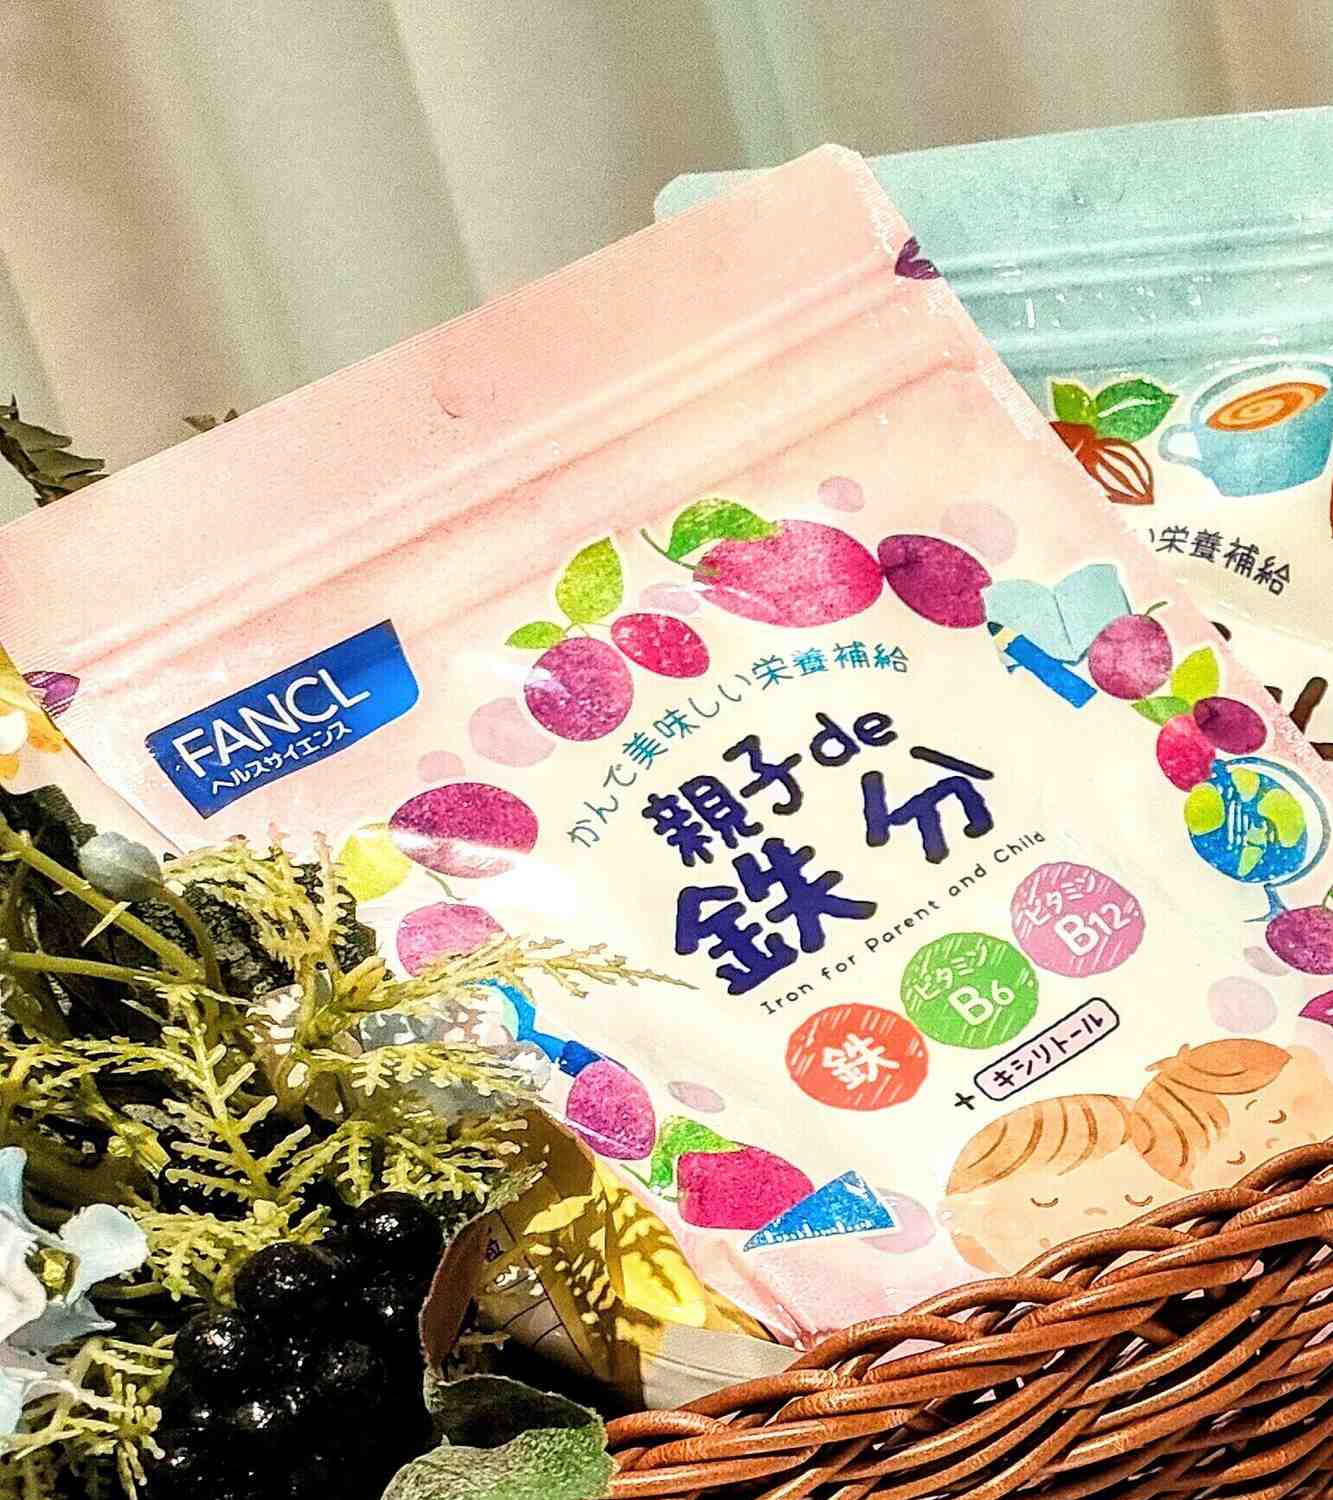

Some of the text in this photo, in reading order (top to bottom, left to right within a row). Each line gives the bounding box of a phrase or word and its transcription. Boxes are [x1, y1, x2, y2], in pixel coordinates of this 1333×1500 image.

[172, 668, 372, 779] FANCL
[211, 720, 353, 795] ヘルスサイエンス
[566, 640, 910, 849] かんで美味しい栄養補給
[641, 711, 899, 868] 親子de
[674, 745, 996, 996] 鉄分
[1025, 873, 1097, 926] ビタミン
[760, 830, 1047, 1016] Iron for Parent and Child
[1055, 902, 1132, 957] B12
[915, 943, 988, 1001] ビタミン
[948, 979, 1015, 1027] B6
[821, 1032, 900, 1091] 鉄
[994, 1013, 1105, 1088] キシリトール
